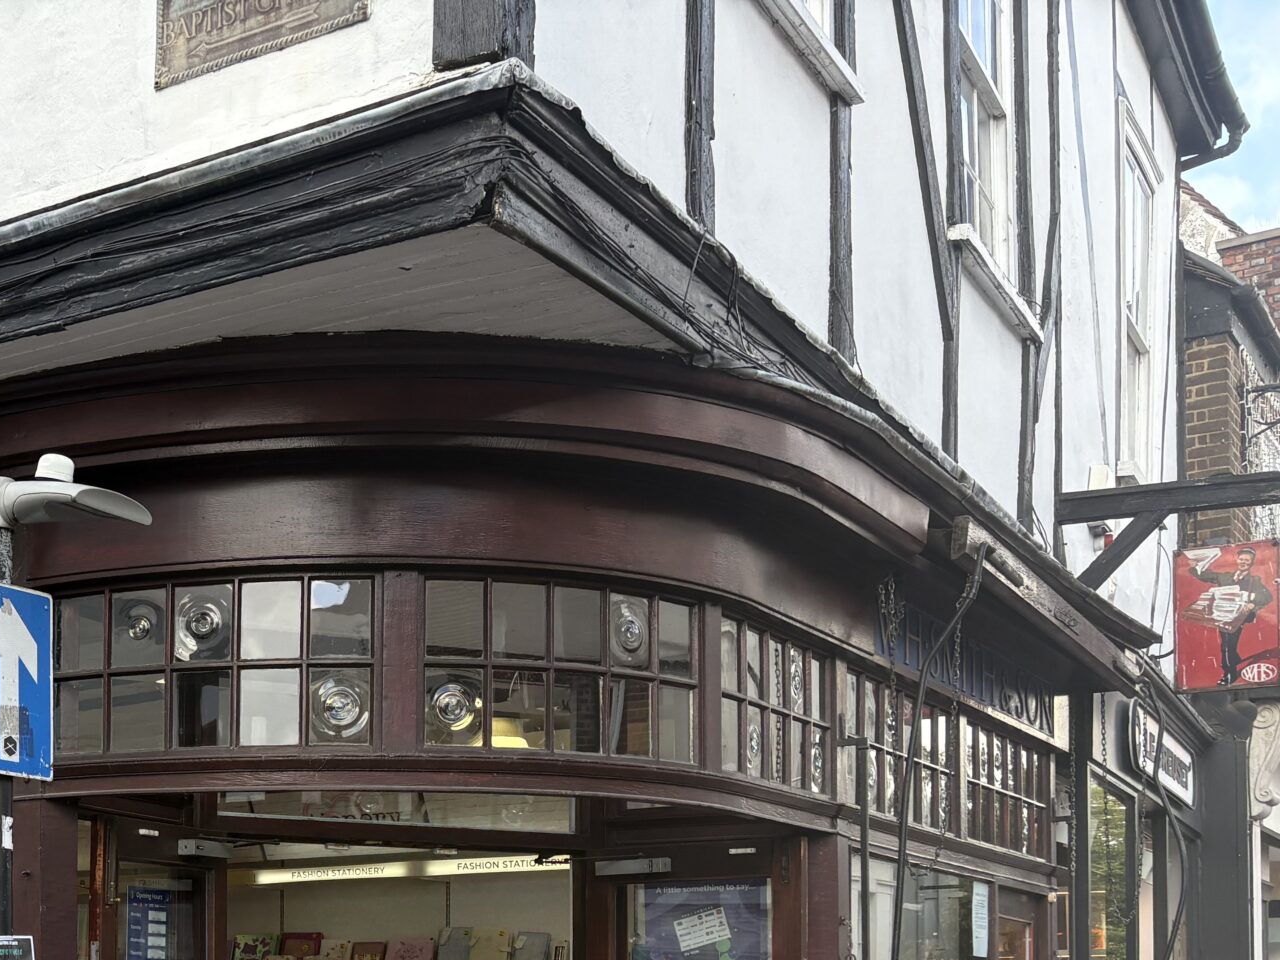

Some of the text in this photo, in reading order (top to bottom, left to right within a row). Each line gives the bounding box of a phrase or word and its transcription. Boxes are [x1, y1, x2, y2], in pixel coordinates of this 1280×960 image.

[161, 0, 247, 47] BAPTIST
[457, 861, 500, 870] FASHION
[291, 867, 385, 879] FASHION STATIONERY
[663, 886, 681, 894] little
[682, 884, 725, 894] something
